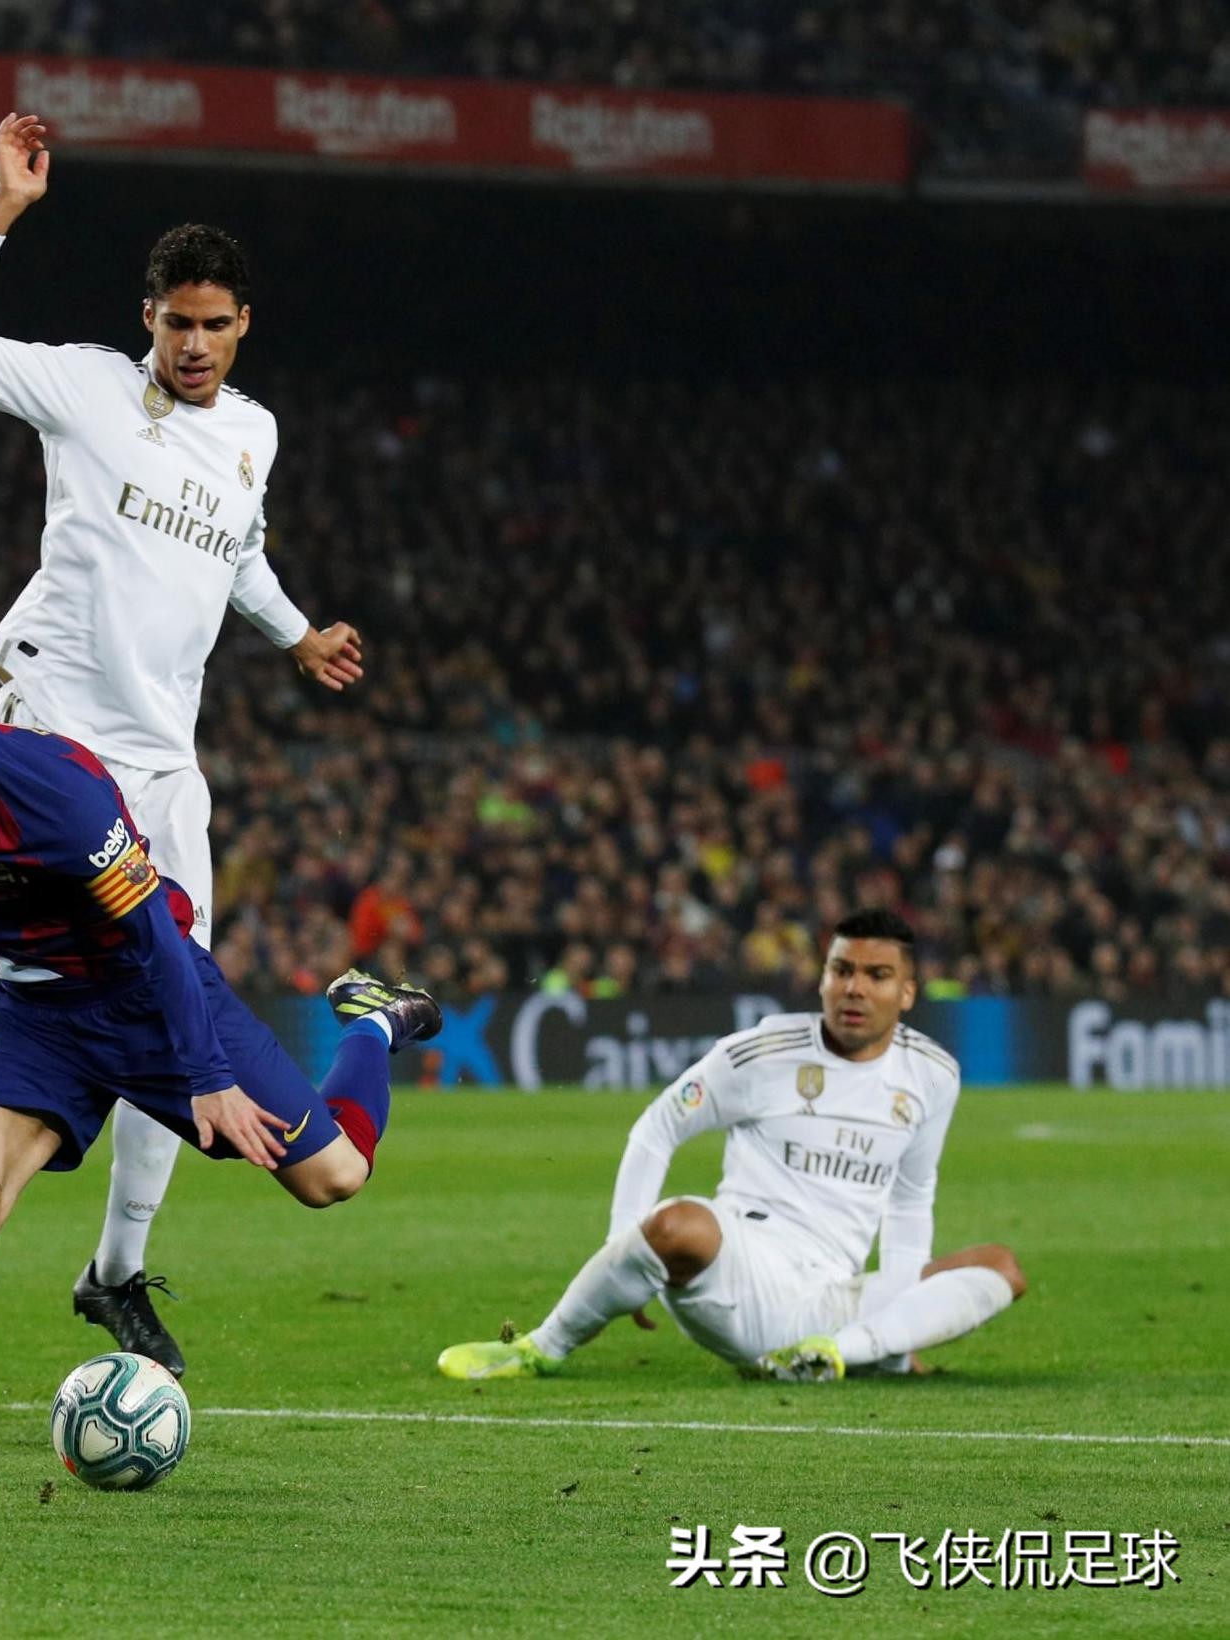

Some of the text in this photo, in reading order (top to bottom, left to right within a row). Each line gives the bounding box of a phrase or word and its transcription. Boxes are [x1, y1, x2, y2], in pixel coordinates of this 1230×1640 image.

[13, 62, 205, 130] Rakuten
[117, 482, 242, 567] Emirates
[180, 478, 221, 518] Fly
[88, 818, 128, 869] beko
